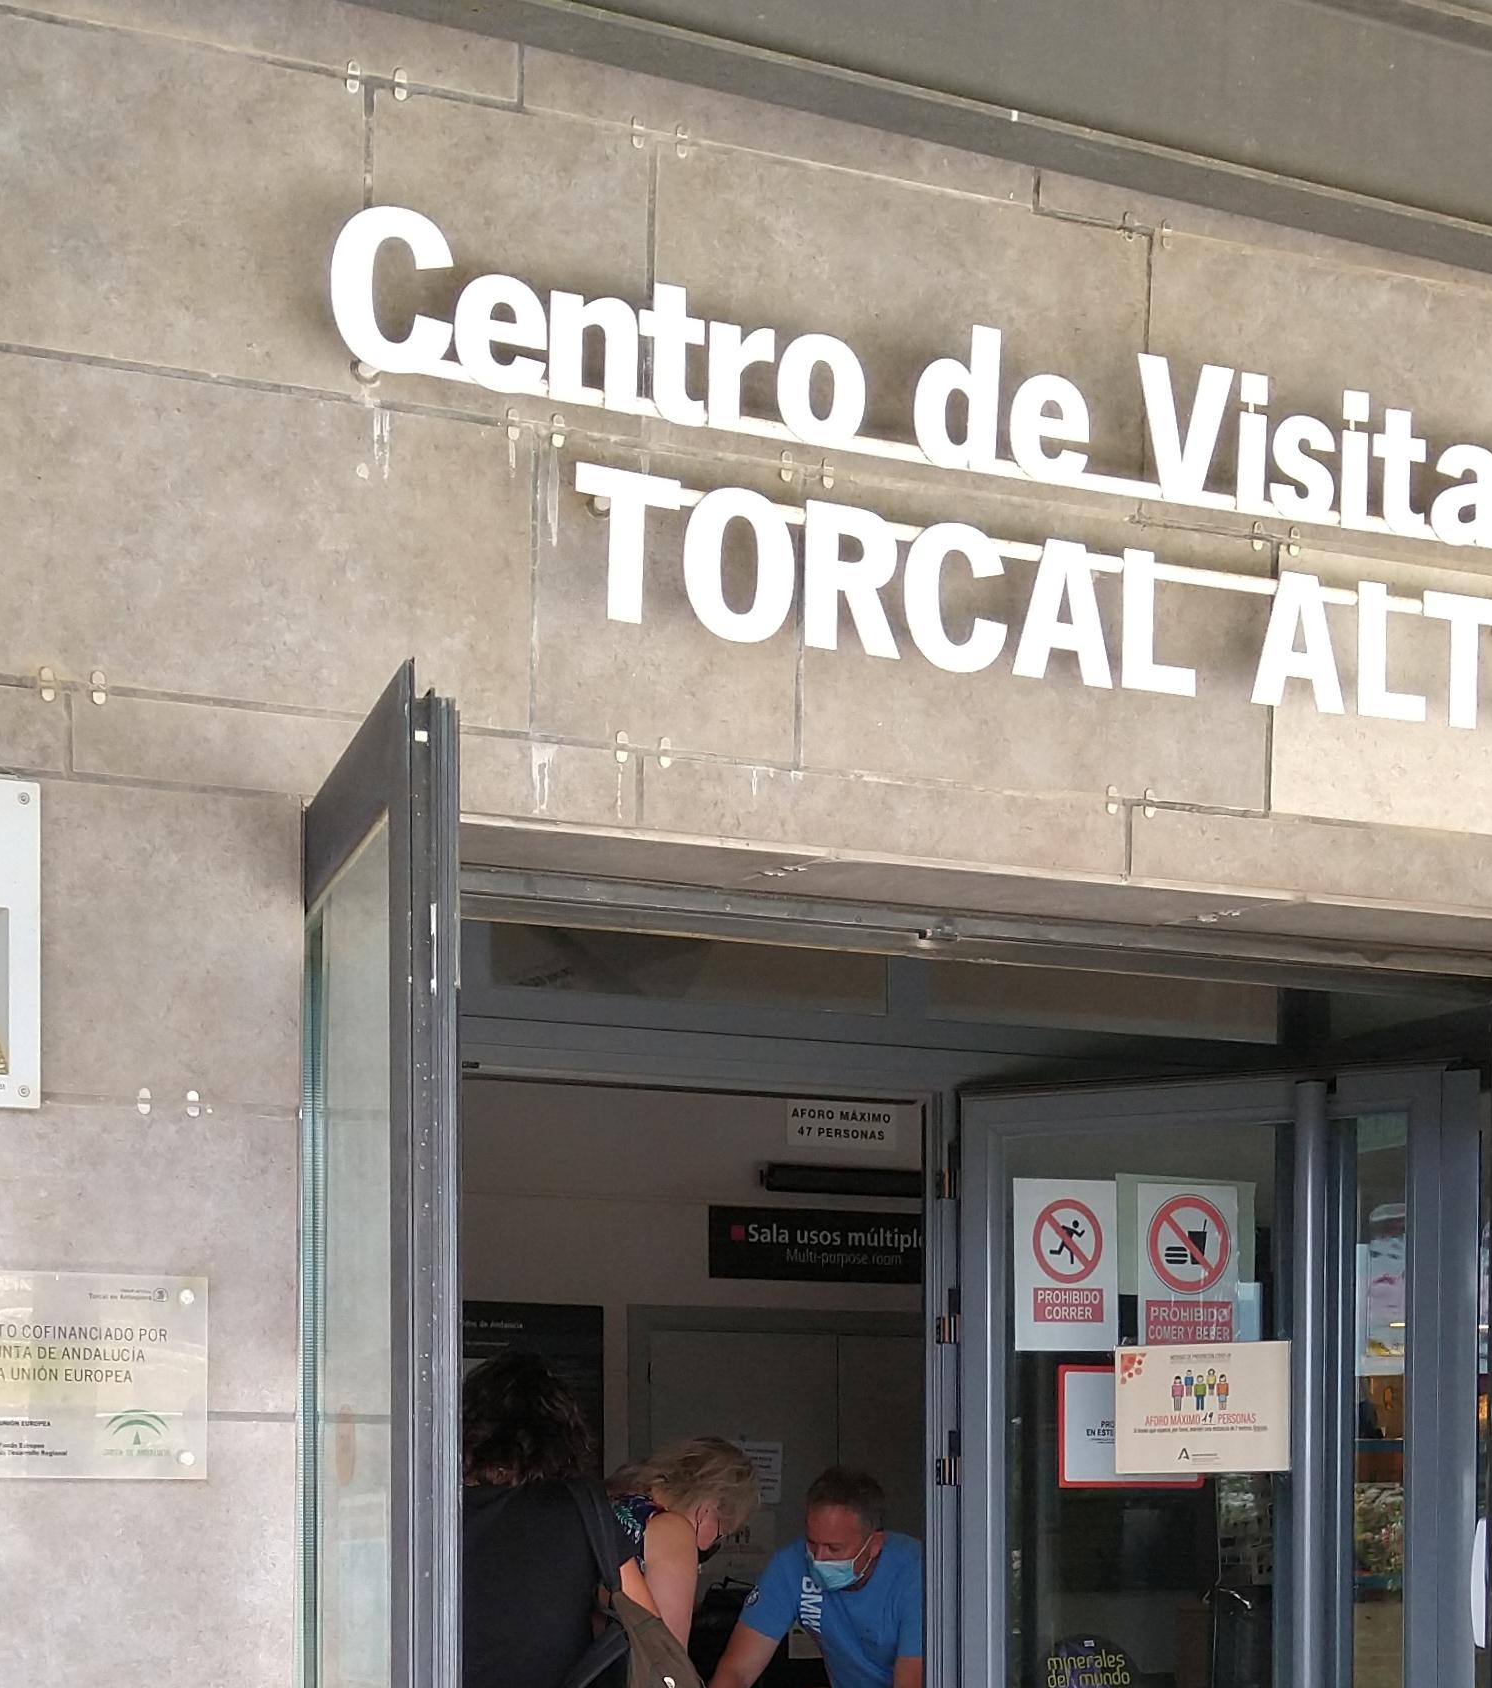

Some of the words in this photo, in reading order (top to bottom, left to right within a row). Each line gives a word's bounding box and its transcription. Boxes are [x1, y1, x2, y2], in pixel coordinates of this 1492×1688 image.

[329, 203, 866, 444] Centro
[913, 327, 1091, 478] de
[574, 465, 1197, 698] TORCAL
[791, 1108, 835, 1120] AFORO
[839, 1109, 891, 1124] MÁXIMO
[797, 1126, 813, 1137] 47
[817, 1127, 885, 1141] PERSONAS
[747, 1223, 789, 1244] Sala
[796, 1229, 841, 1246] usos
[786, 1249, 868, 1269] Multi-purpose
[871, 1253, 903, 1265] room
[1037, 1290, 1100, 1305] PROHIBIDO
[1045, 1306, 1093, 1320] CORRER
[1150, 1307, 1231, 1322] PROHIBIDO
[22, 1325, 135, 1343] COFINANCIADO
[138, 1328, 168, 1343] POR
[1148, 1325, 1184, 1340] COMER
[1186, 1325, 1193, 1340] Y
[1196, 1325, 1230, 1341] BEBER
[37, 1346, 58, 1360] DE
[61, 1345, 146, 1363] ANDALUCÍA
[11, 1364, 59, 1381] UNIÓN
[64, 1368, 134, 1384] EUROPEA
[1145, 1413, 1169, 1427] AFORO
[1170, 1411, 1201, 1426] MÁXIMO
[1218, 1413, 1257, 1425] PERSONAS
[1047, 1649, 1126, 1671] minerales
[1047, 1668, 1070, 1688] del
[1079, 1667, 1130, 1686] mundo
